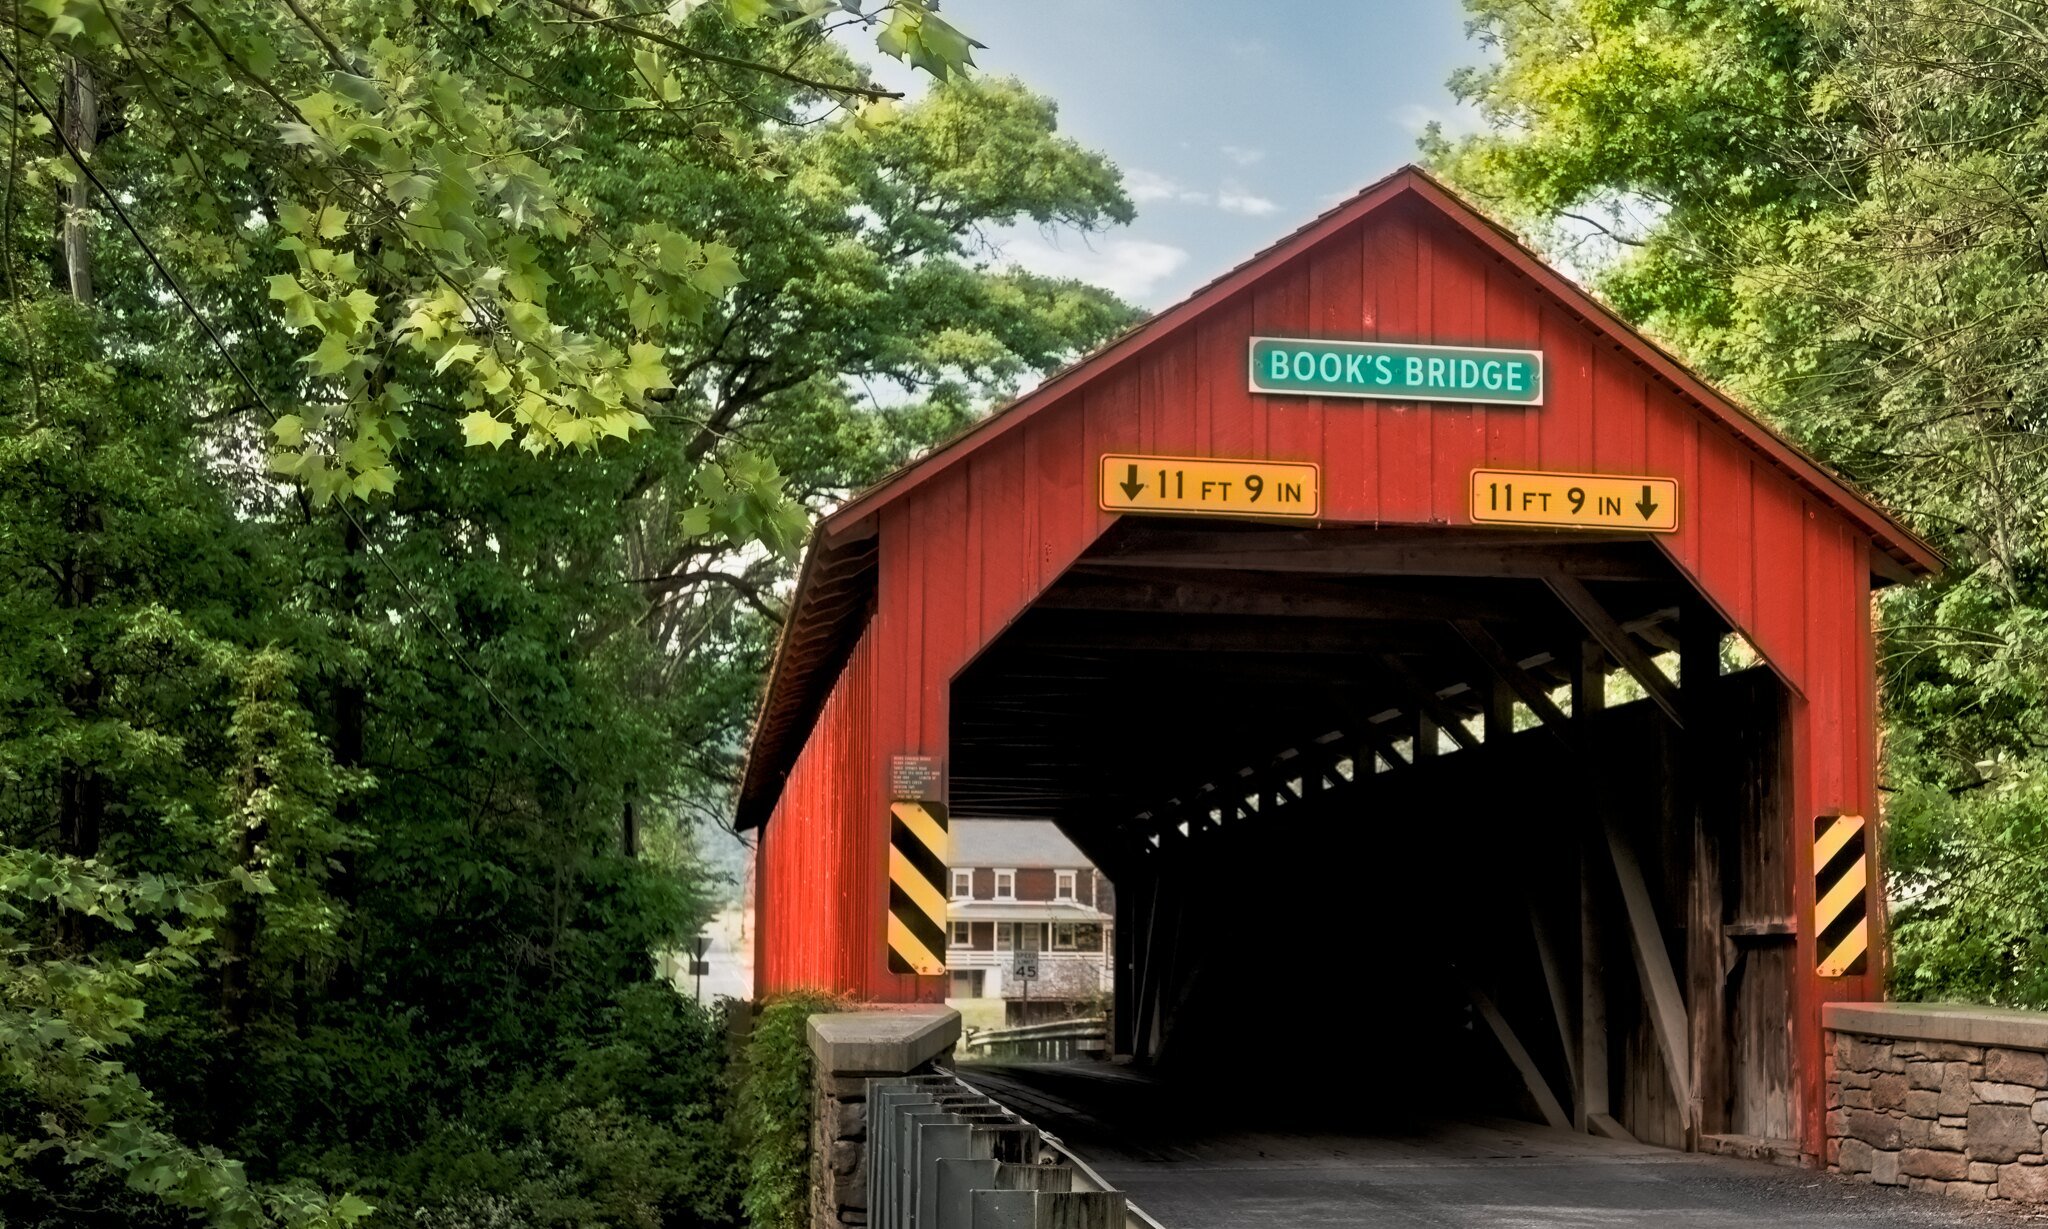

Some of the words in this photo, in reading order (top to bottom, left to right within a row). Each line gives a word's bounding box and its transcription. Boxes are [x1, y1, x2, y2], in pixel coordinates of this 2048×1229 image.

[1271, 350, 1393, 385] BOOK'S
[1405, 357, 1523, 391] BRIDGE
[1159, 470, 1183, 499] 11
[1202, 481, 1232, 501] FT
[1244, 474, 1264, 503] 9
[1277, 483, 1301, 502] IN
[1490, 483, 1512, 511] 11
[1523, 492, 1552, 512] FT
[1567, 487, 1586, 515] 9
[1599, 496, 1621, 516] IN
[1016, 966, 1036, 978] 45
